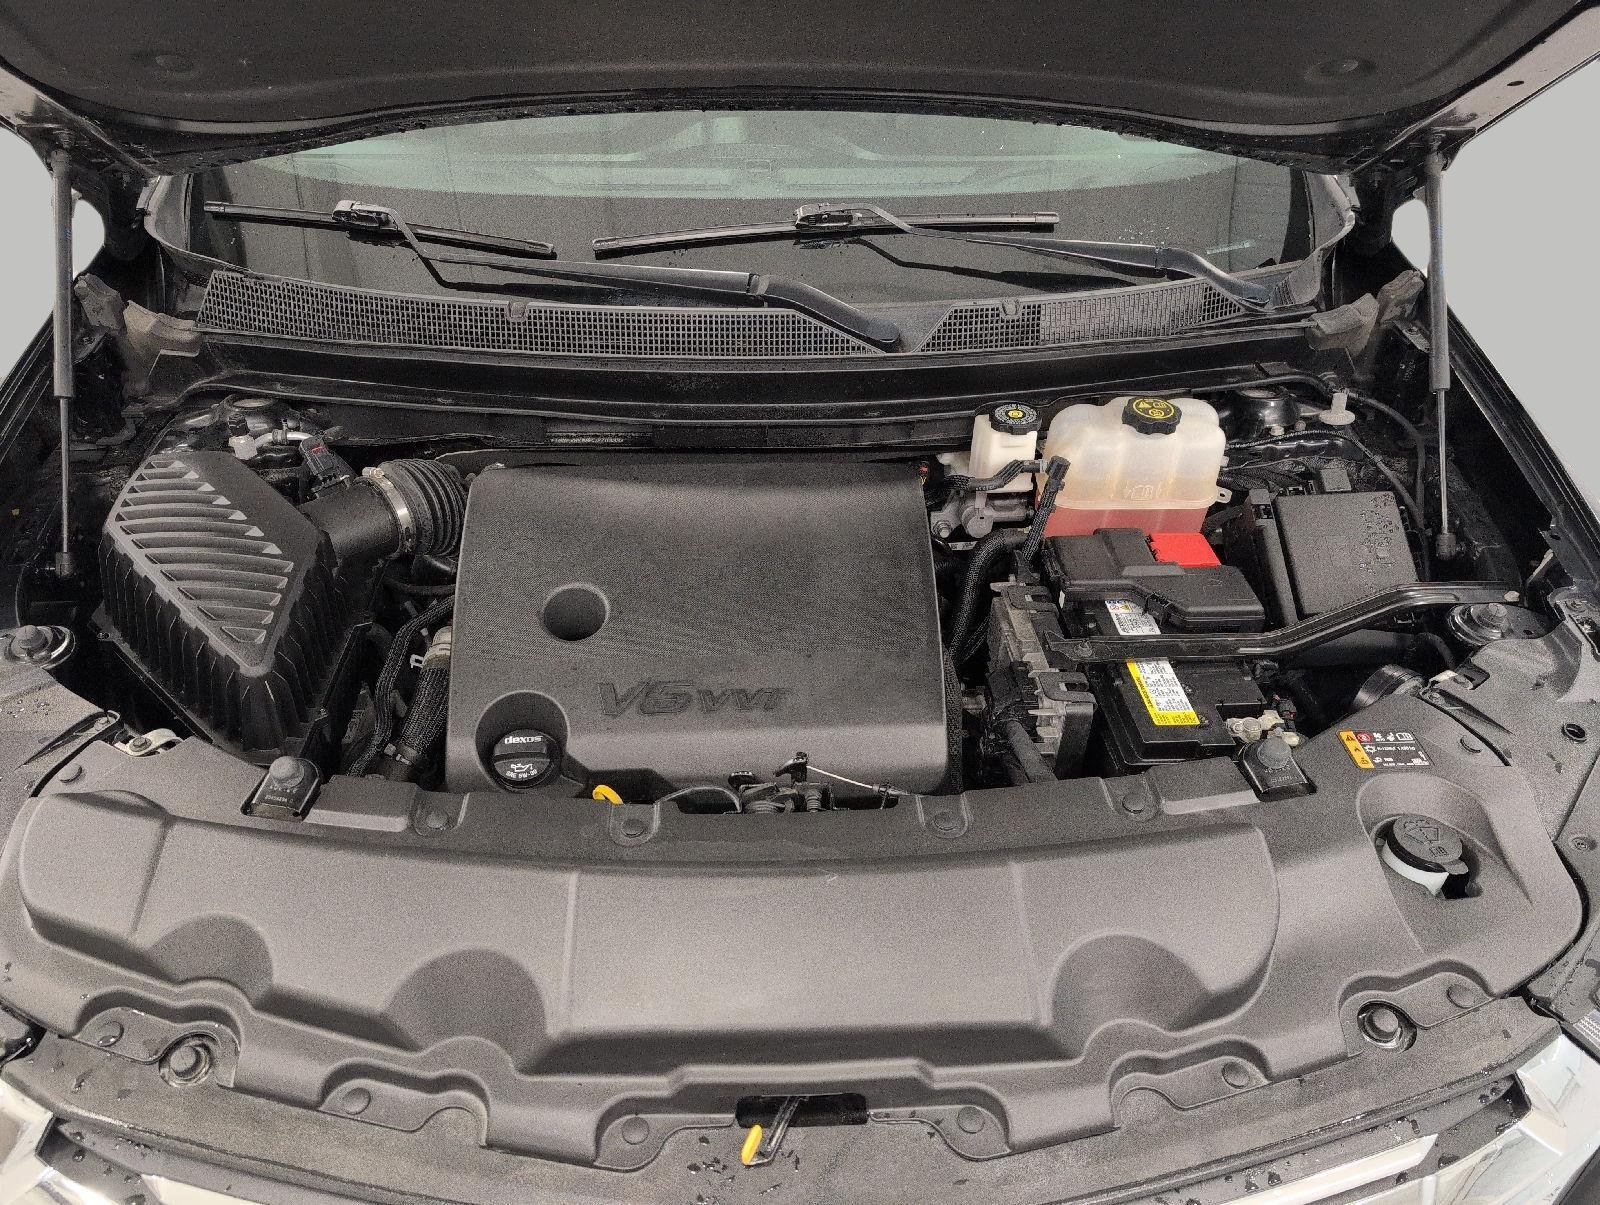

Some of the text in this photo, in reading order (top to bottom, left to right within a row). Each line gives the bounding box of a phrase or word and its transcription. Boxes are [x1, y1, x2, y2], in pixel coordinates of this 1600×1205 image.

[598, 680, 792, 718] V6 VVT
[504, 735, 543, 744] dexos
